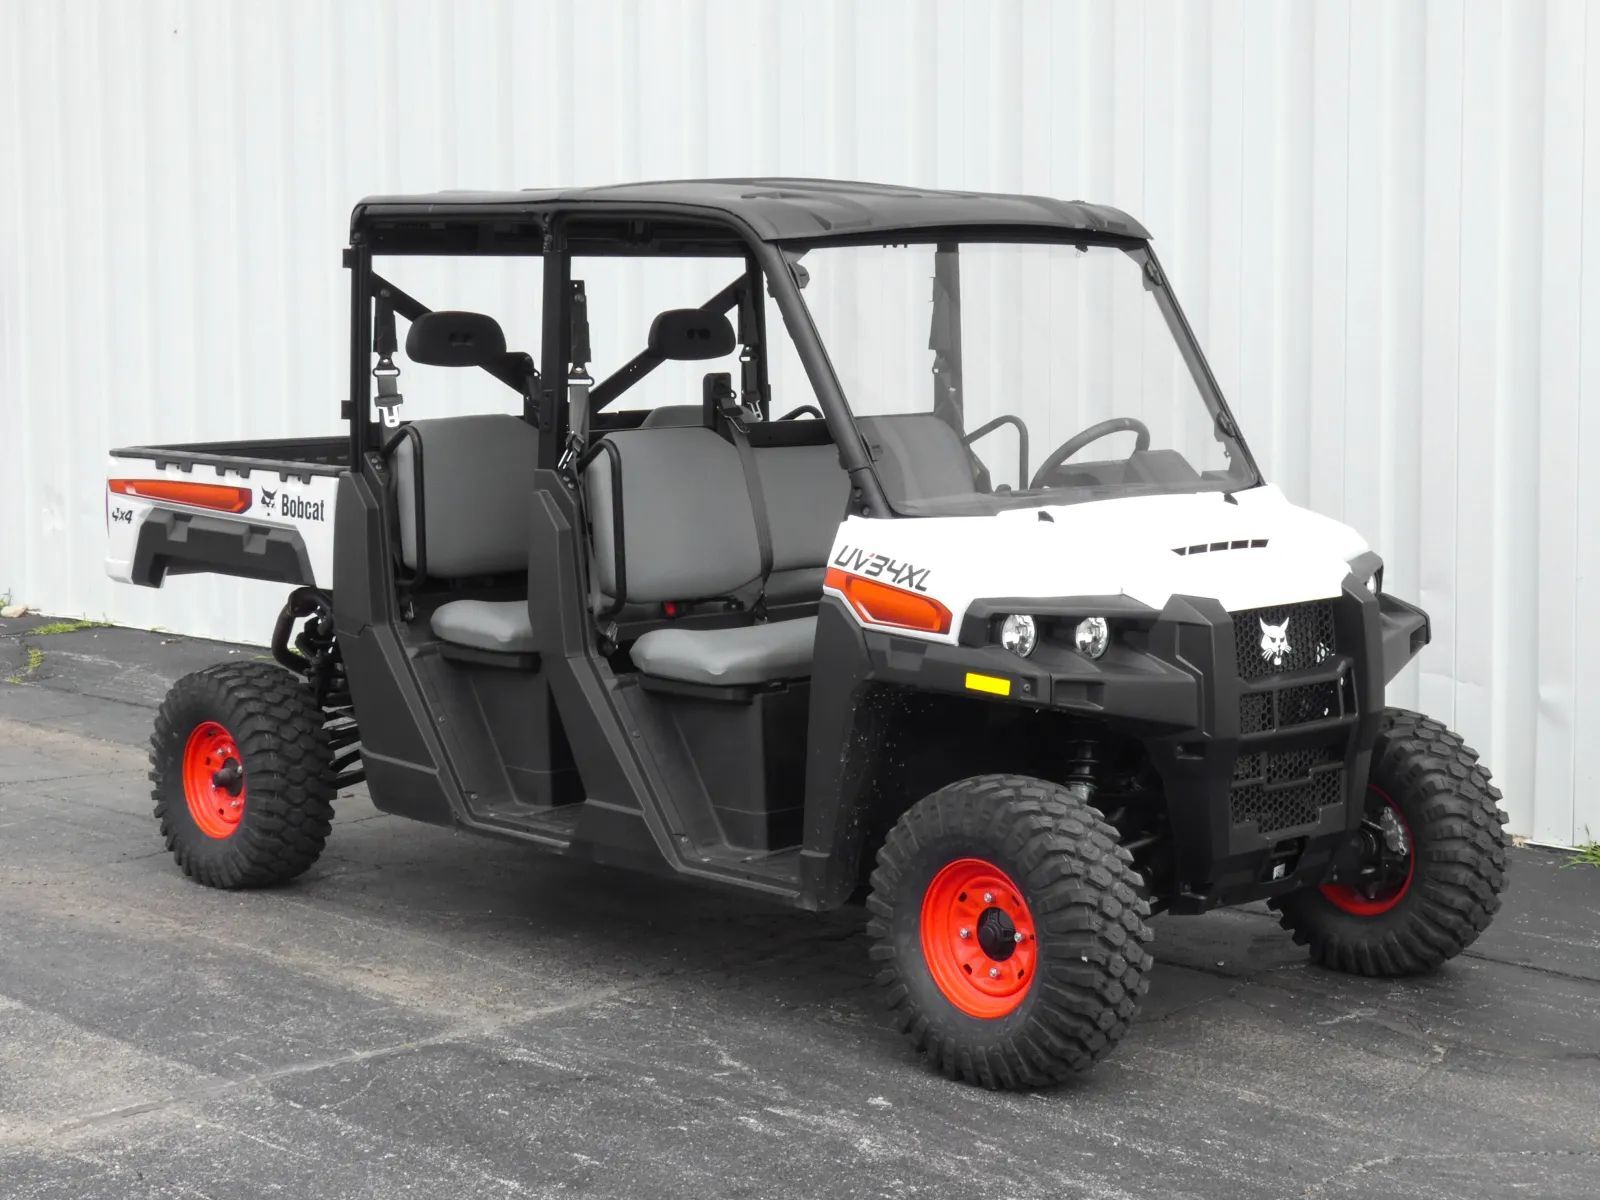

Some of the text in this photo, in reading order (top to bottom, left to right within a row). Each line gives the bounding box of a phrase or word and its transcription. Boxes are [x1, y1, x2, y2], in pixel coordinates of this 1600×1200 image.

[111, 507, 134, 524] 4x4
[281, 493, 325, 522] Bobcat
[834, 545, 931, 592] UV34XL
